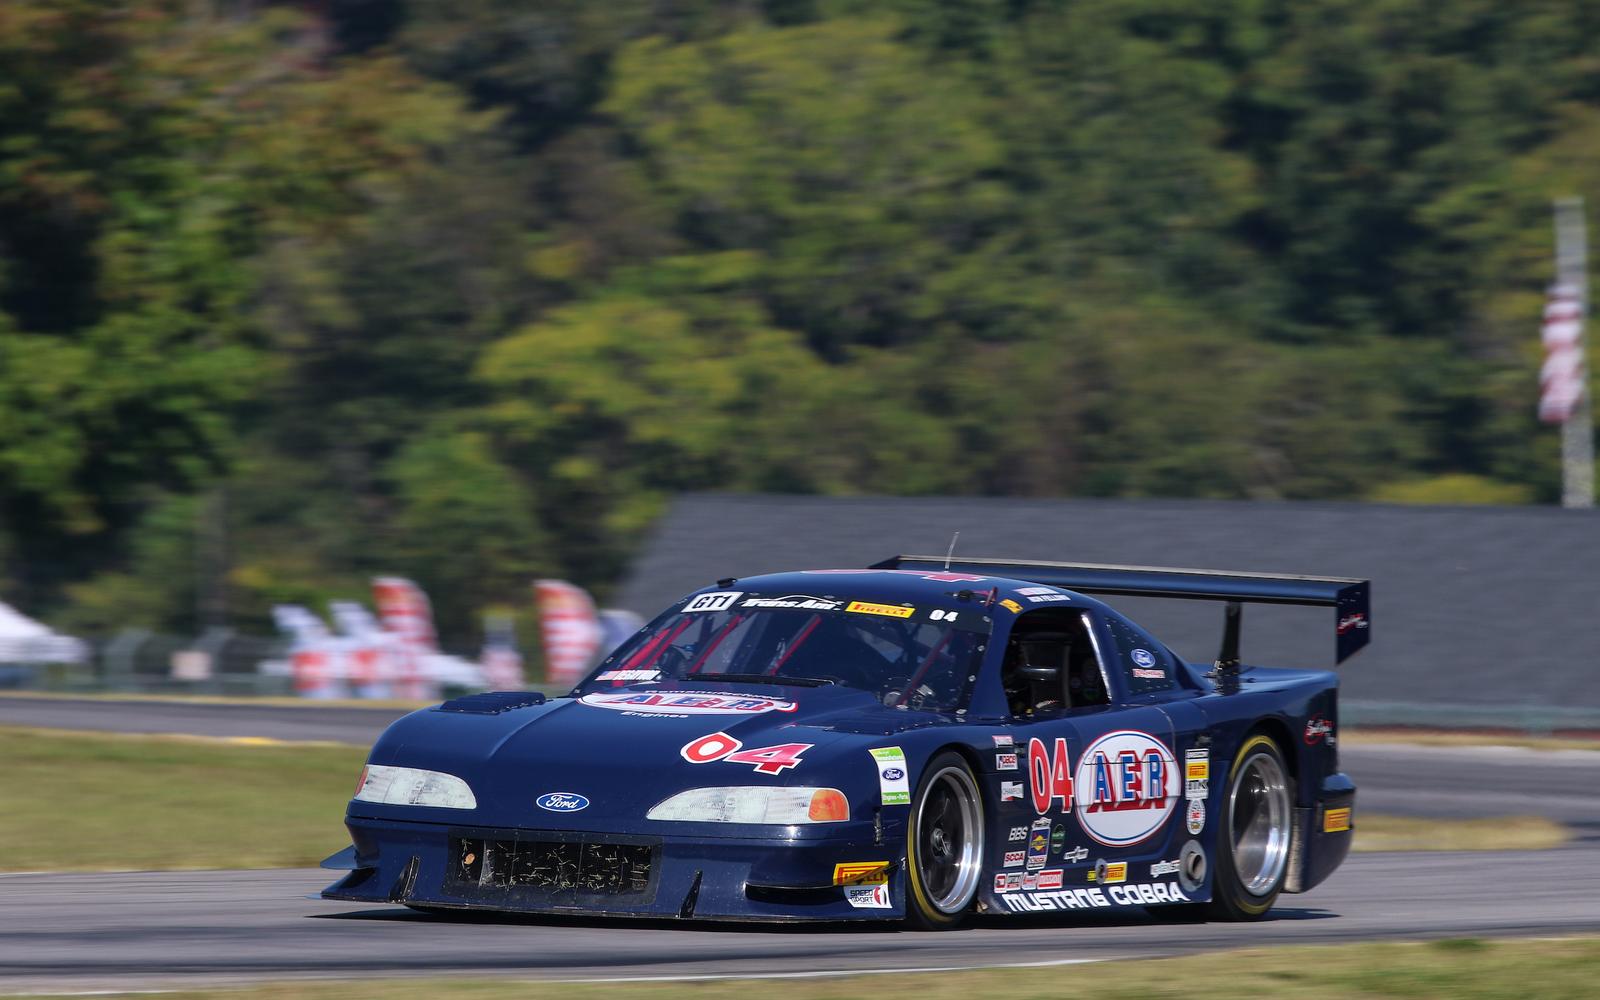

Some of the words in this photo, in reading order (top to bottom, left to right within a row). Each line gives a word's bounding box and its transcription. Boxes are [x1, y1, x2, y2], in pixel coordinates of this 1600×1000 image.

[691, 596, 732, 610] GT1
[929, 609, 959, 622] 04
[597, 694, 775, 711] AER
[680, 731, 815, 775] 04
[885, 769, 902, 780] Ford
[1028, 737, 1074, 815] 04
[1087, 750, 1168, 813] AER
[544, 794, 581, 809] Ford
[1008, 827, 1028, 841] BBS
[1005, 852, 1024, 862] SCCA
[849, 889, 874, 897] SPEED
[1001, 887, 1110, 912] MUSTANG
[1108, 882, 1191, 906] COBRA
